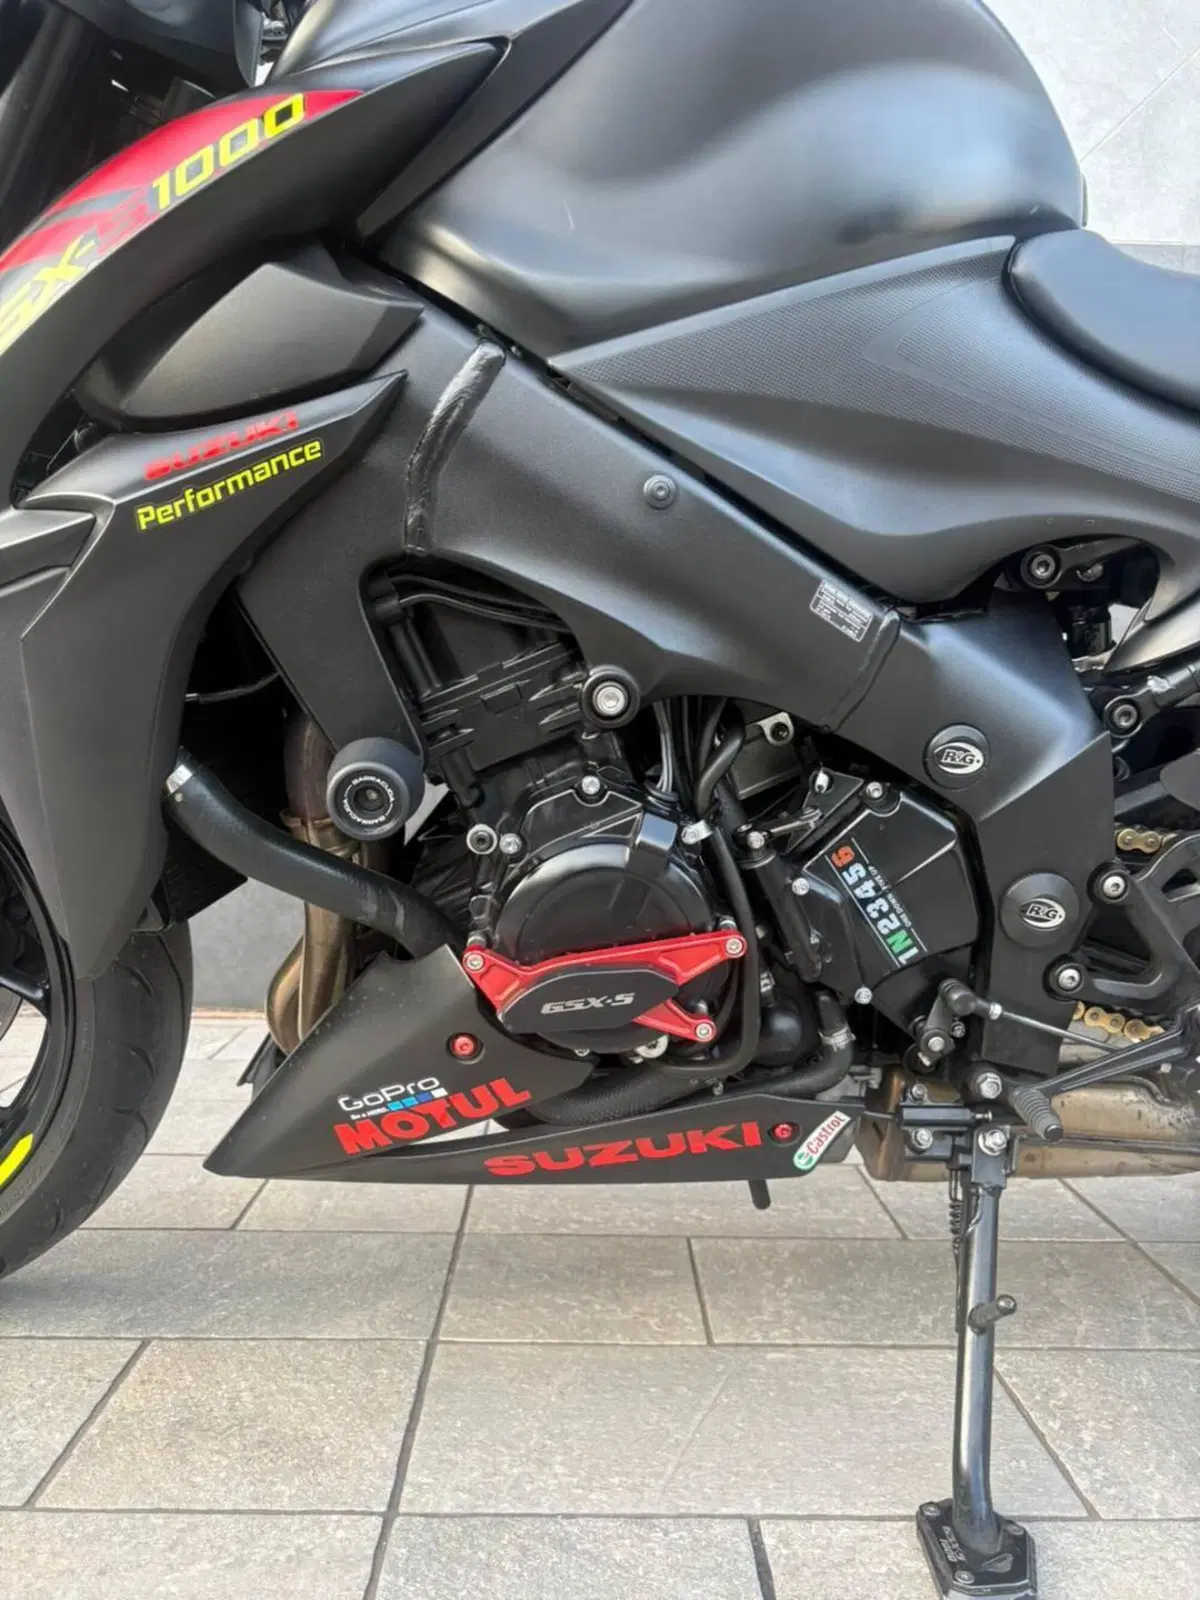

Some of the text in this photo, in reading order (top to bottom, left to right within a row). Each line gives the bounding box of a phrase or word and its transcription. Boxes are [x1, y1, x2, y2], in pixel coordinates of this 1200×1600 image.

[143, 411, 299, 480] SUZUKI
[136, 439, 323, 531] Performance
[541, 992, 636, 1014] GSX-S
[334, 1077, 532, 1155] MOTUL
[338, 1077, 440, 1111] GoPro
[484, 1121, 761, 1176] SUZUKI
[806, 1115, 846, 1156] Castrol
